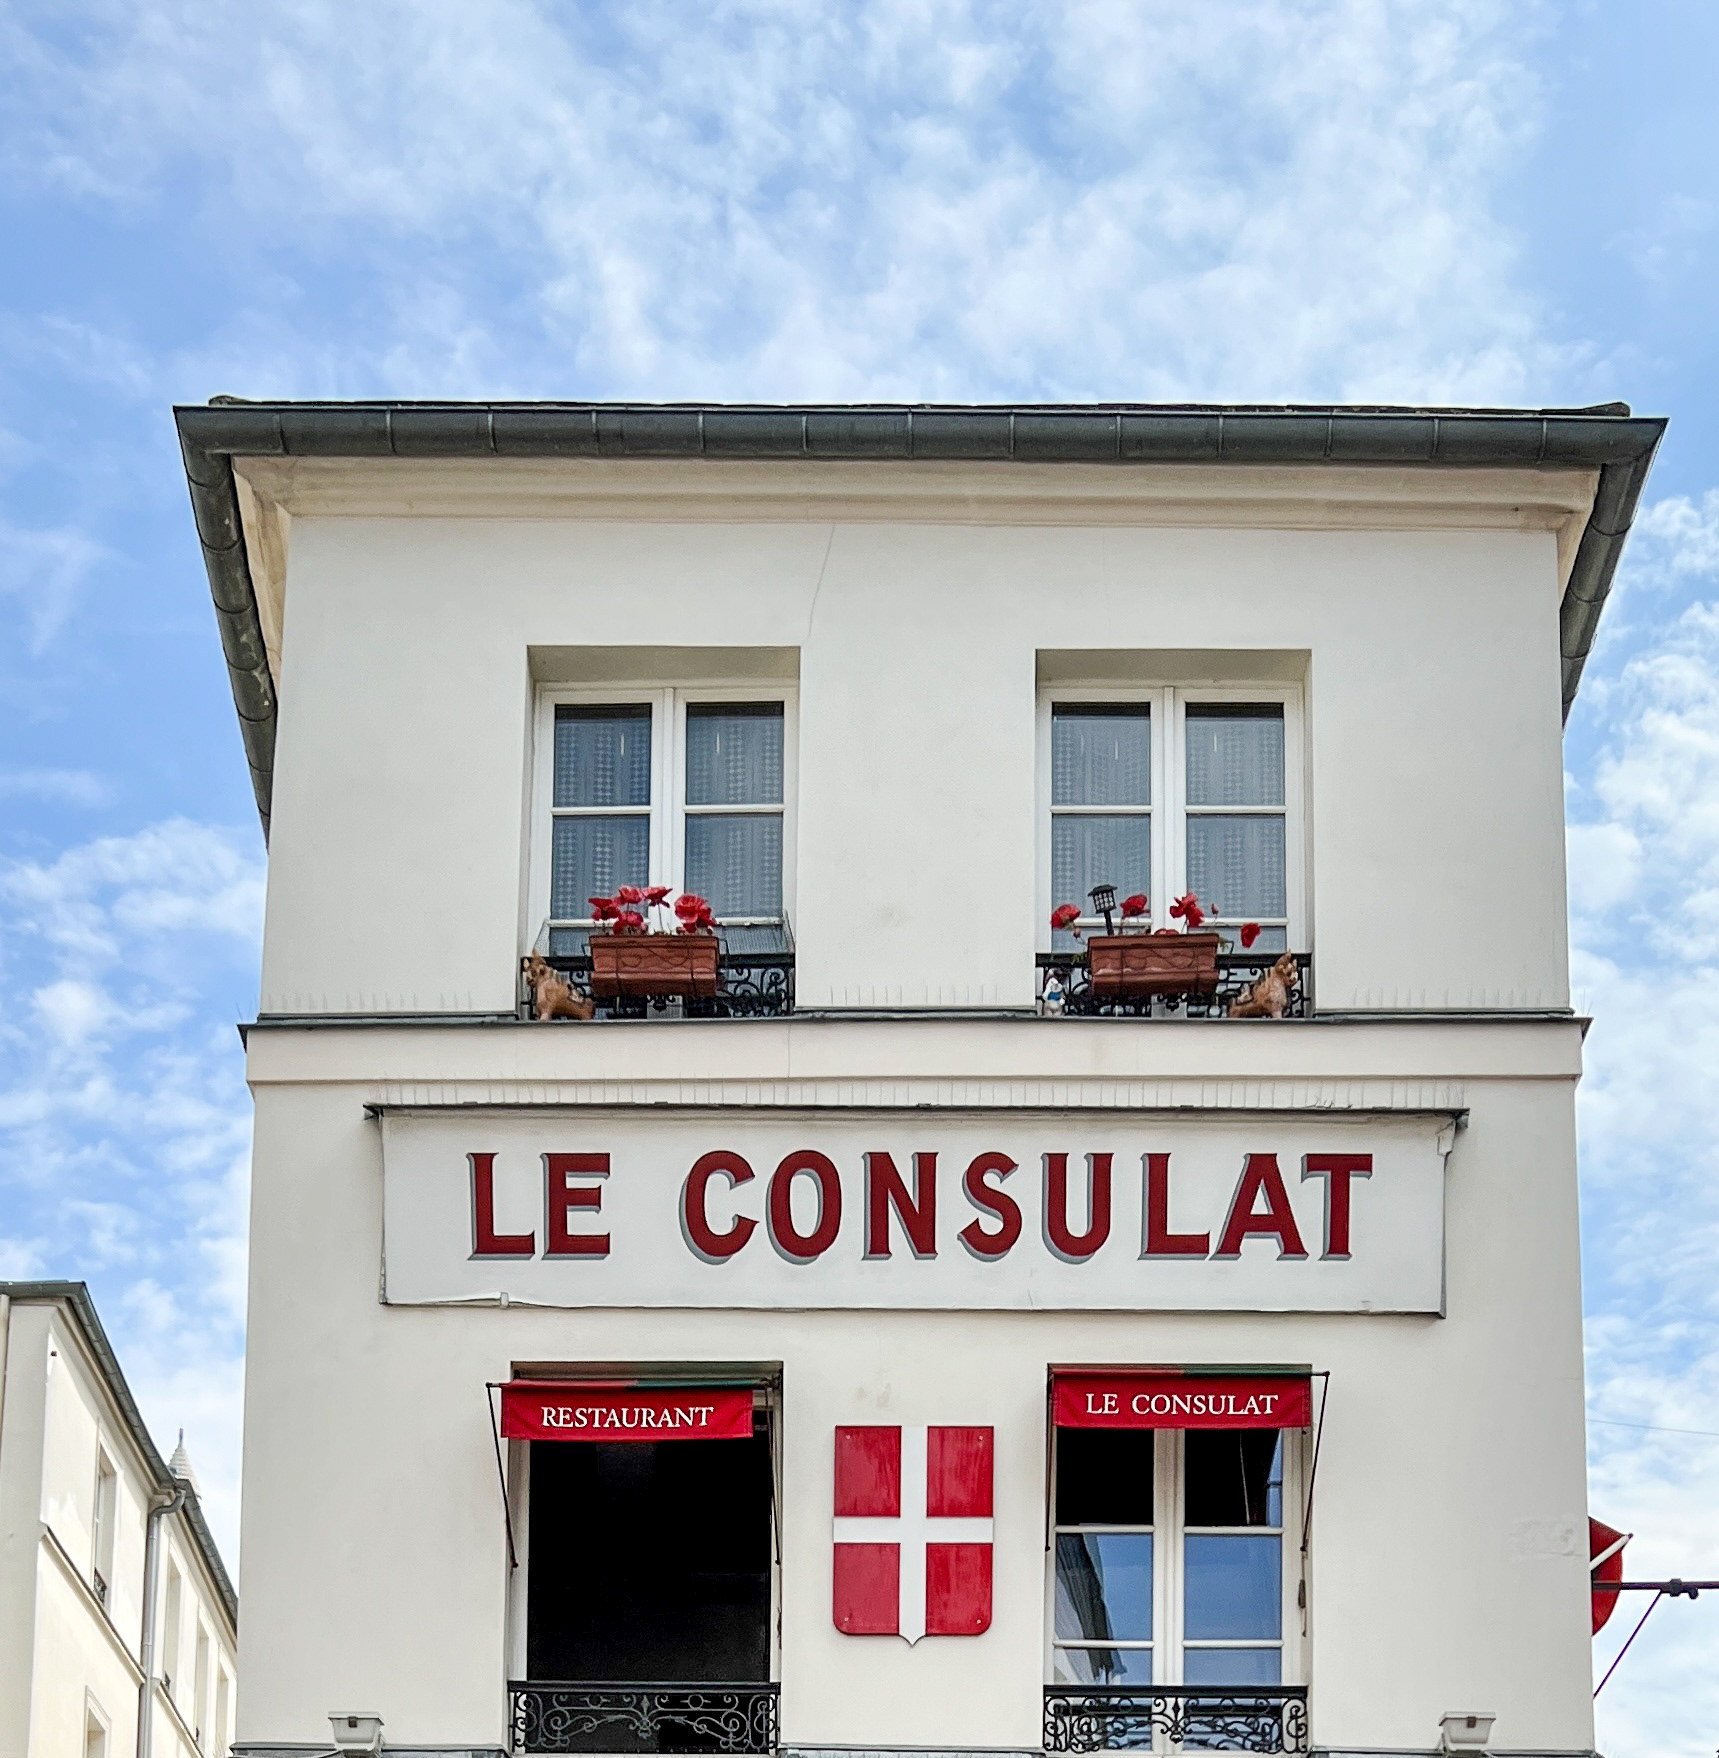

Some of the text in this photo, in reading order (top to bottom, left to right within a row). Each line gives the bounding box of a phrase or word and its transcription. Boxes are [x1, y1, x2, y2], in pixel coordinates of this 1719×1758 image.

[466, 1150, 1373, 1264] LE CONSULAT
[1086, 1393, 1279, 1417] LE CONSULAT
[541, 1406, 713, 1430] RESTAURANT
